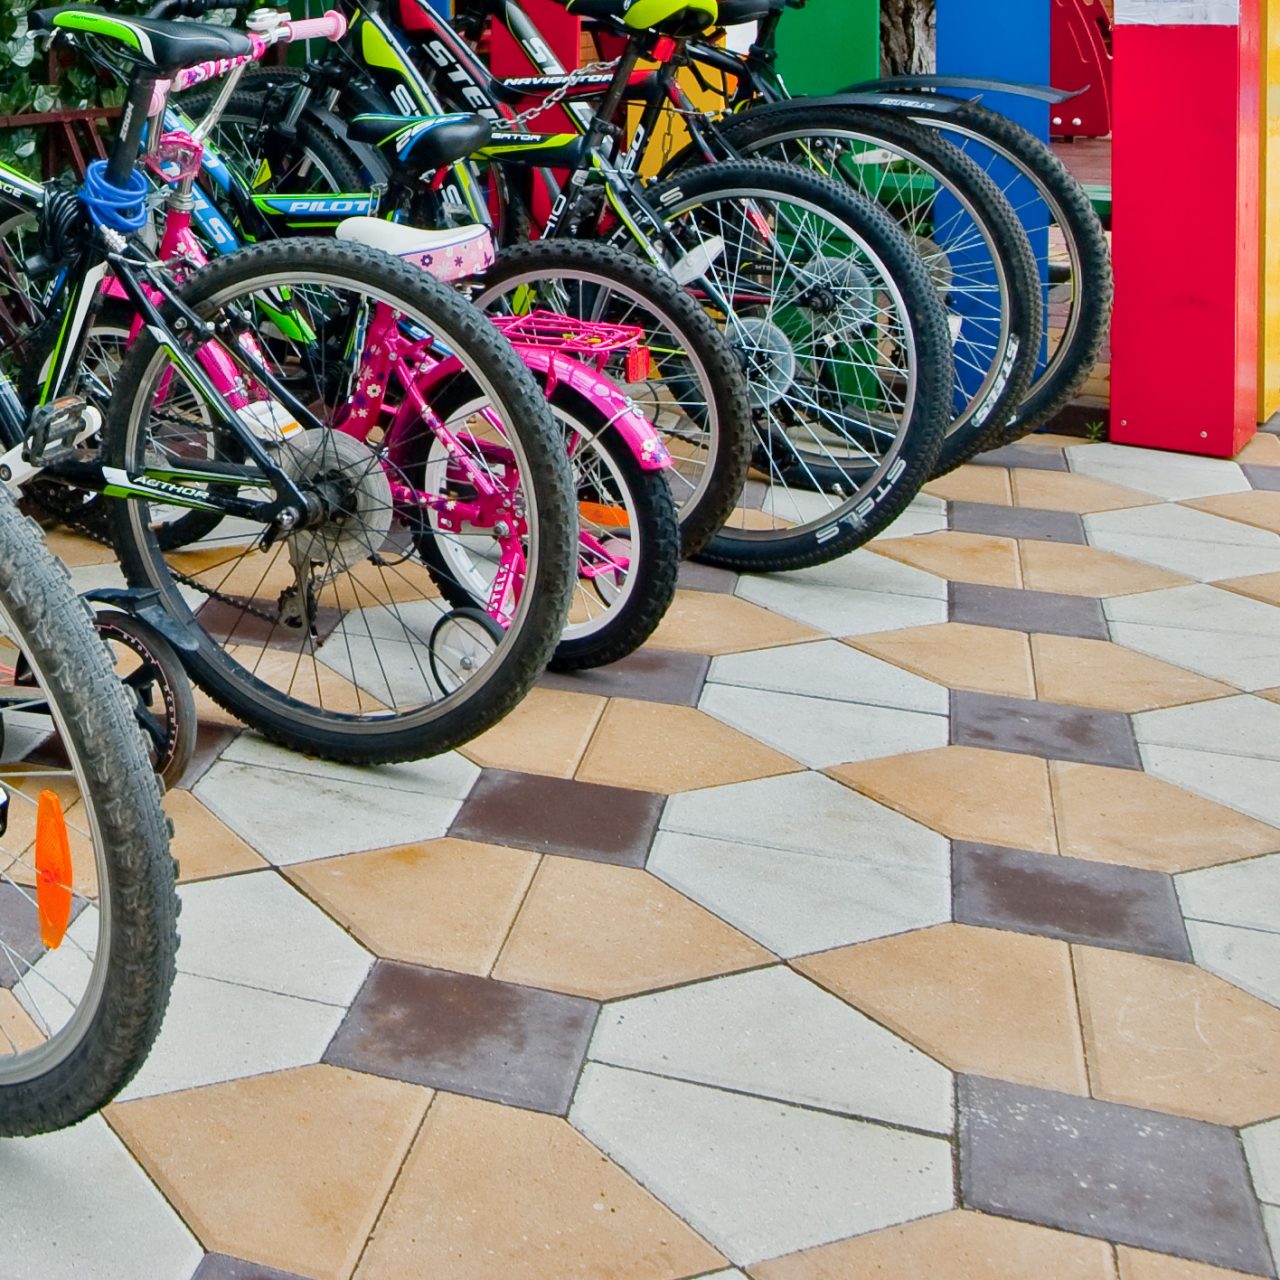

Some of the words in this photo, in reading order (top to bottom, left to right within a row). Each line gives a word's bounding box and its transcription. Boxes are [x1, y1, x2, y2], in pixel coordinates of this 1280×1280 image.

[422, 40, 500, 120] STEL
[120, 102, 134, 142] ZOOM
[289, 200, 371, 212] PILOT
[133, 476, 210, 500] AUTHOR
[815, 456, 907, 544] STELS
[488, 563, 510, 611] STELS
